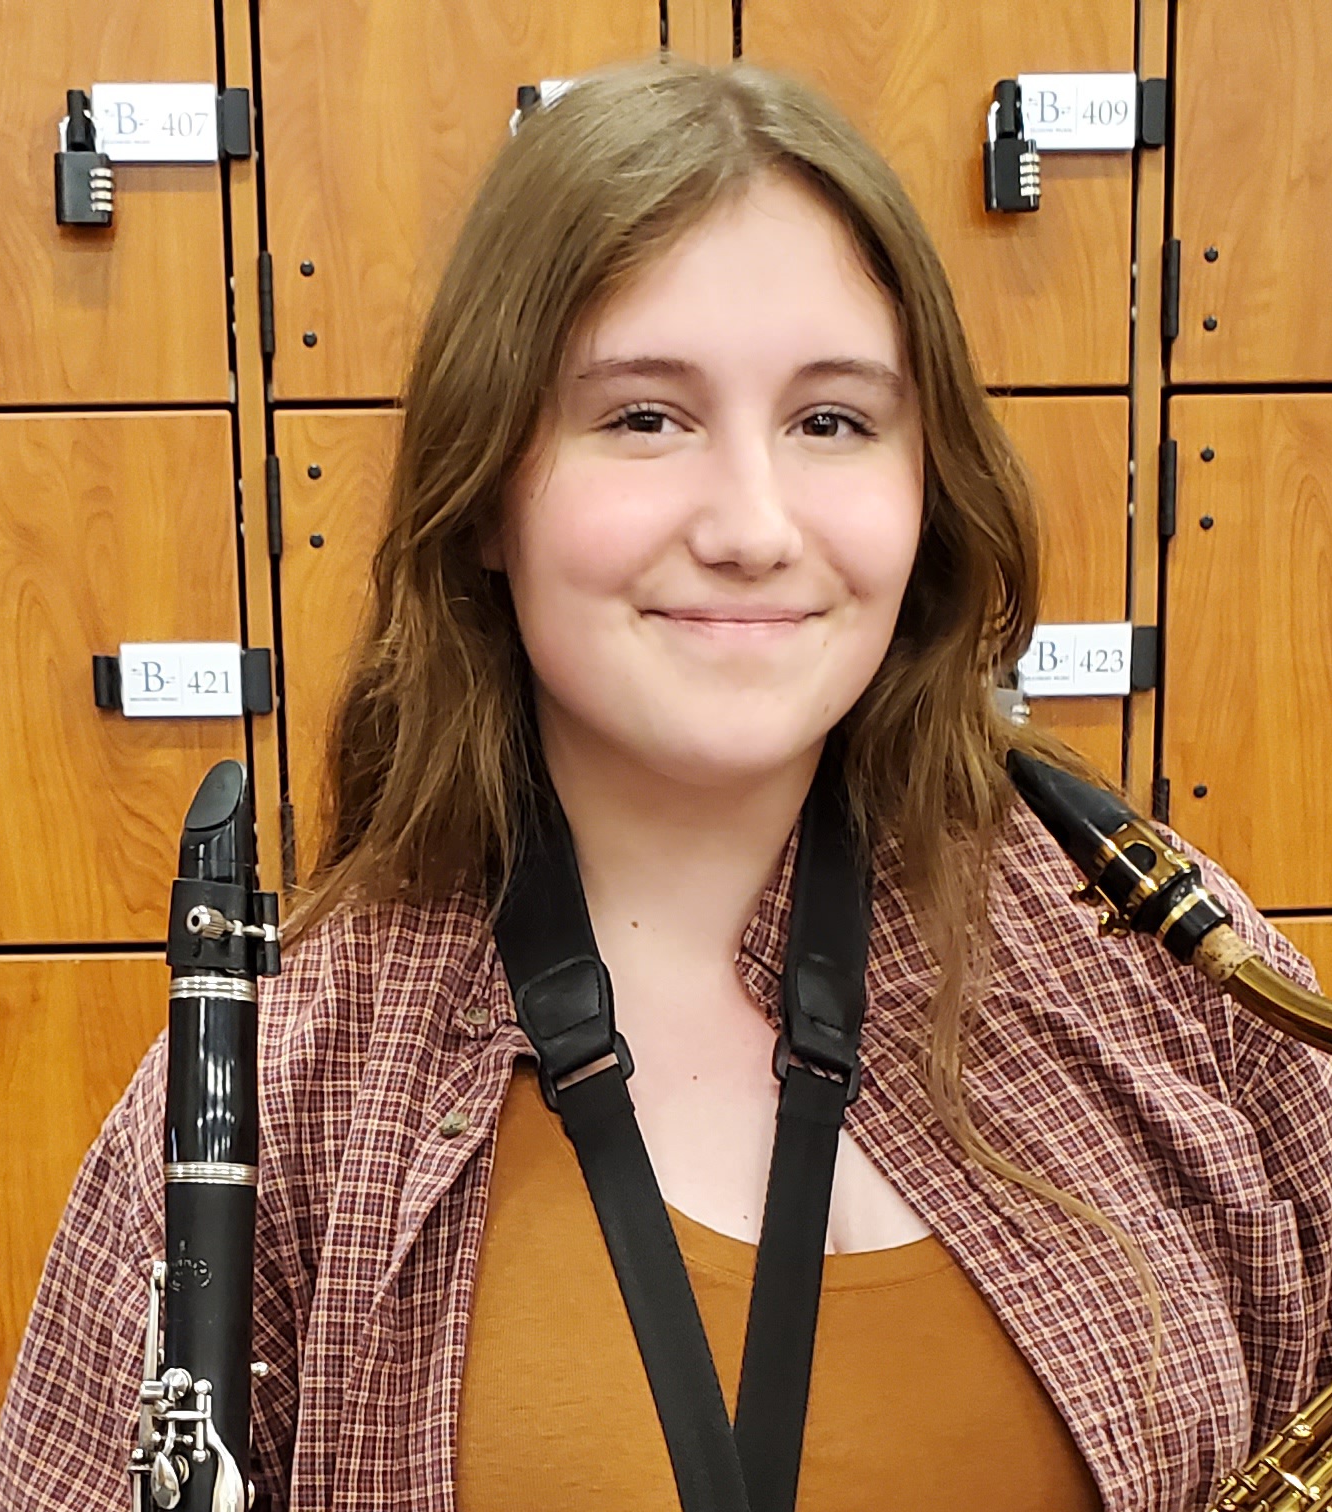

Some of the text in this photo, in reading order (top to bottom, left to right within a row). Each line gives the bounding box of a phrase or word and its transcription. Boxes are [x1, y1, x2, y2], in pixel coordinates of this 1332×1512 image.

[114, 102, 208, 136] B 407
[1038, 91, 1128, 124] B 409
[1038, 641, 1123, 672] B 423
[141, 662, 229, 694] B 421
